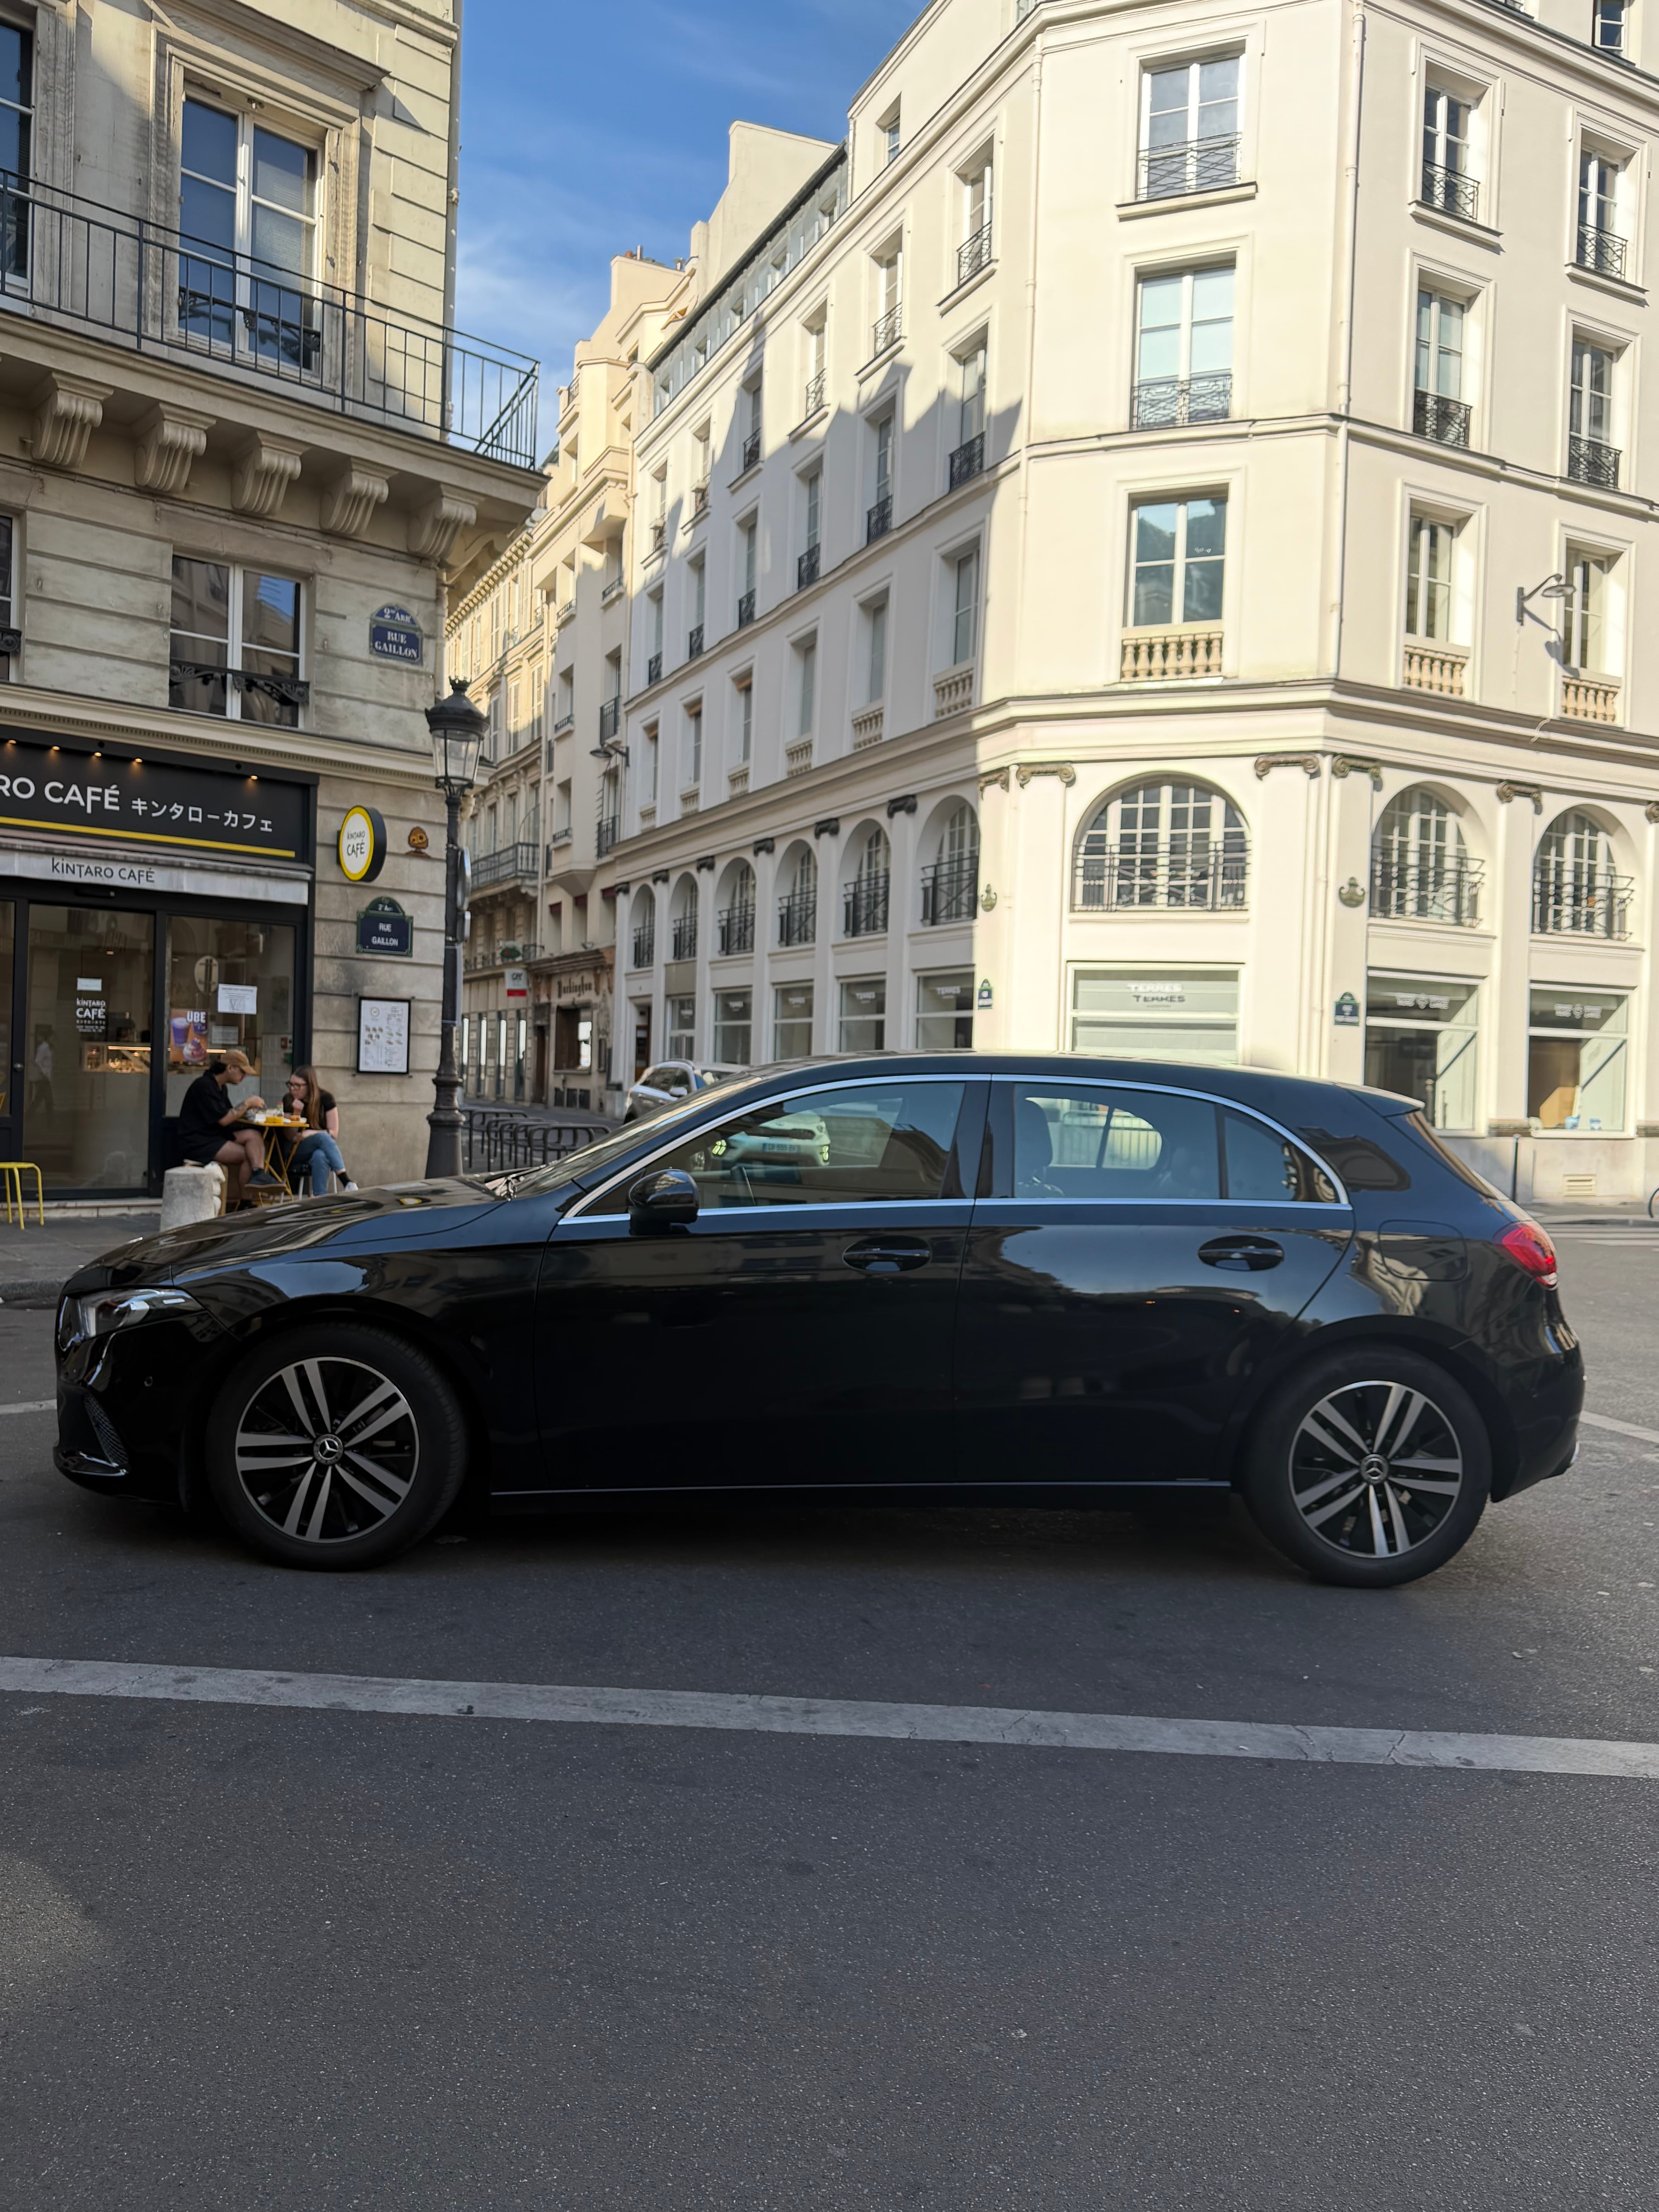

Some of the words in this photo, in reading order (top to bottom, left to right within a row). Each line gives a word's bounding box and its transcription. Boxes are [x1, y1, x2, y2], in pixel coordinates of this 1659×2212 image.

[387, 630, 407, 644] RUE
[374, 641, 417, 658] GAILLON
[44, 781, 120, 814] CAFÉ
[131, 797, 273, 832] キンタローカフェ
[347, 839, 365, 858] CAFÉ
[118, 867, 155, 884] CAFÉ
[379, 922, 392, 933] RUE
[371, 936, 398, 947] GAILLON
[76, 1006, 106, 1020] CAFÉ
[186, 1010, 206, 1024] UBE
